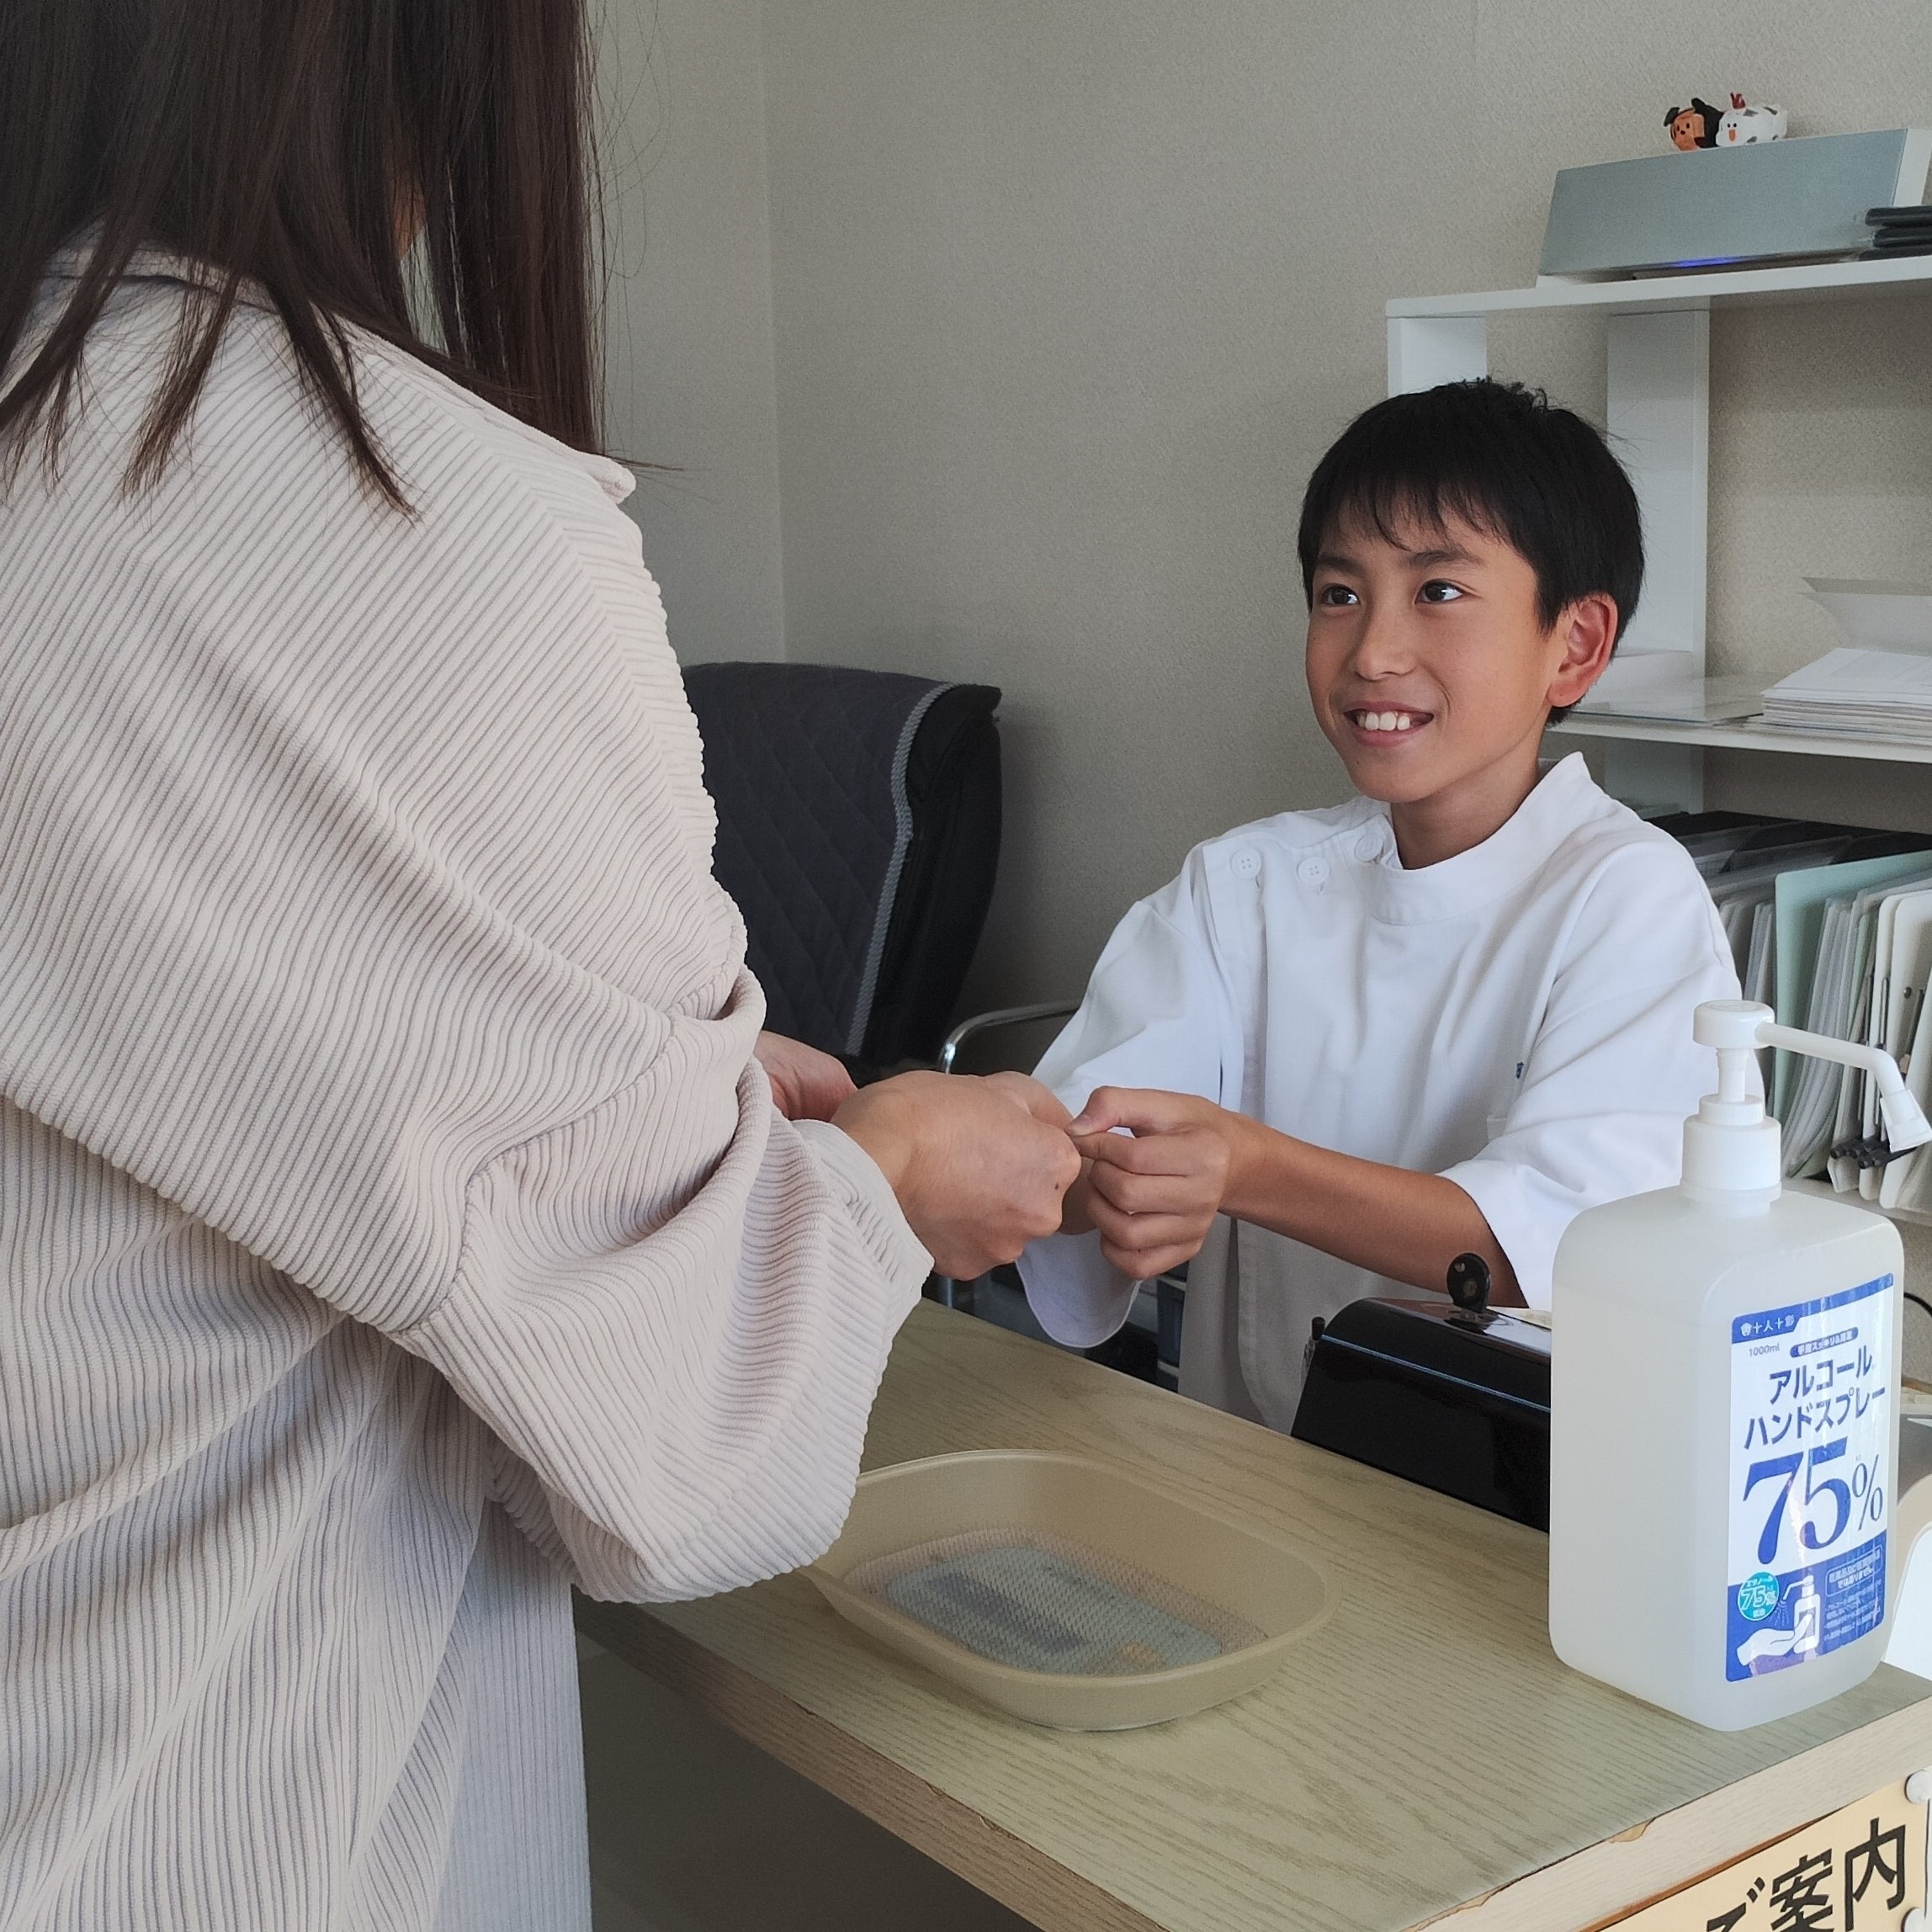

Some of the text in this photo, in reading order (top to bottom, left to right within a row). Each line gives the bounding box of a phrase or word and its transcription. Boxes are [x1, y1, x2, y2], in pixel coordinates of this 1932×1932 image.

[1749, 1343, 1781, 1357] 1000ml
[1770, 1345, 1873, 1404] アルコール
[1744, 1387, 1886, 1450] ハンドスプレー
[1743, 1436, 1884, 1565] 75%
